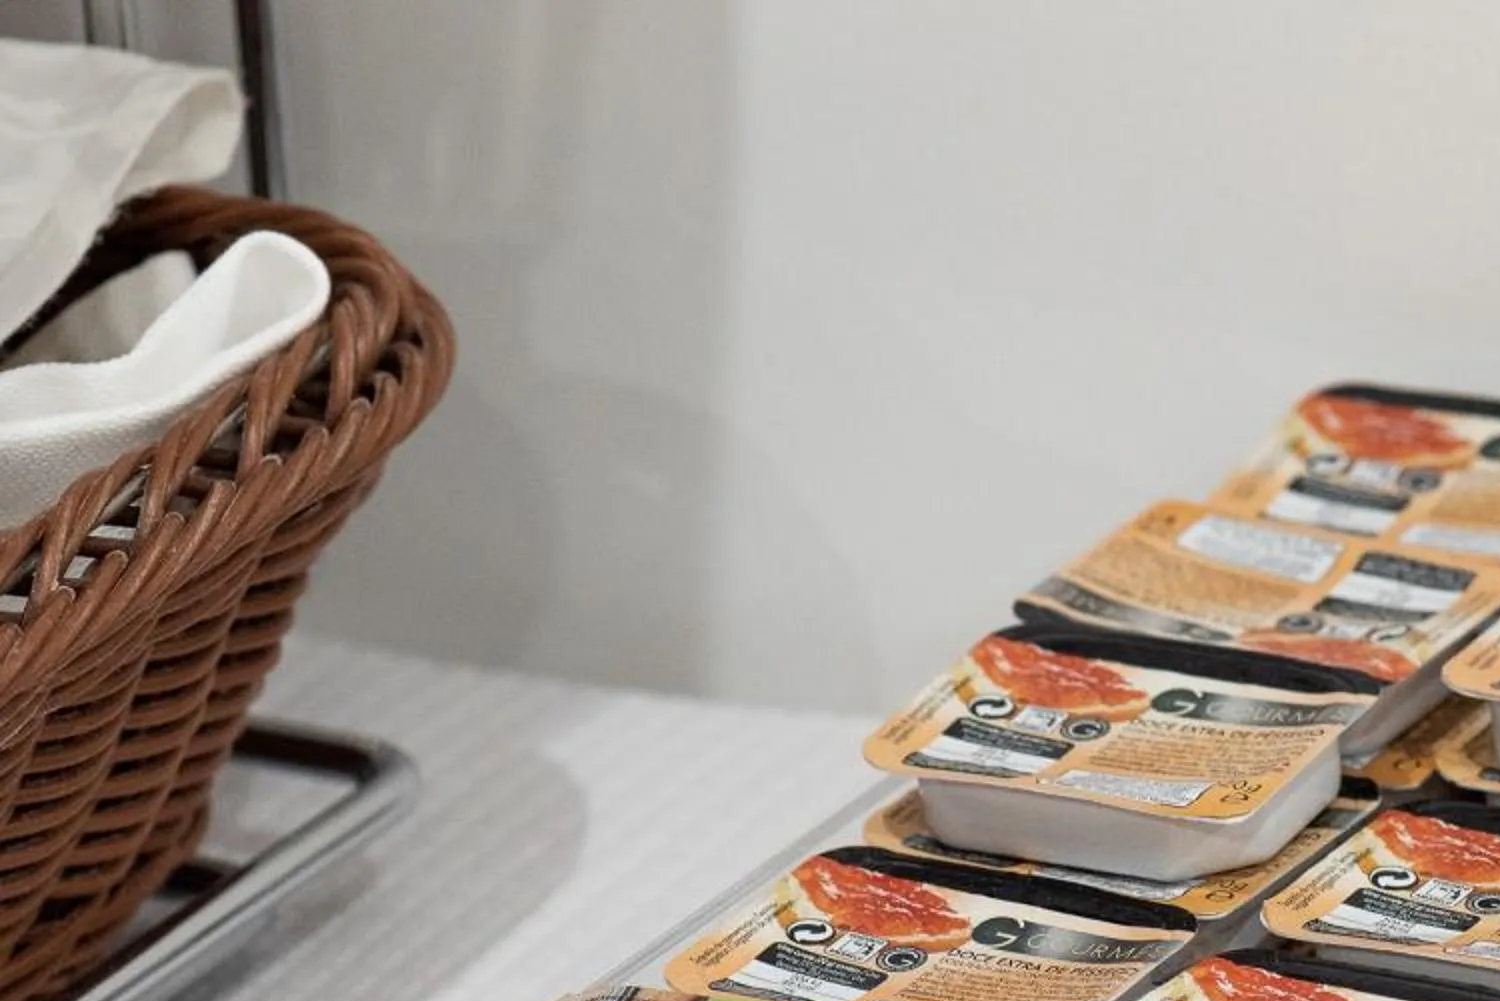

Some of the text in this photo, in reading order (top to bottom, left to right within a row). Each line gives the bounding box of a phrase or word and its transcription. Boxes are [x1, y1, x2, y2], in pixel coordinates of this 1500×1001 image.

[972, 916, 1025, 948] G
[948, 949, 996, 964] DOCE
[996, 957, 1041, 972] EXTRA
